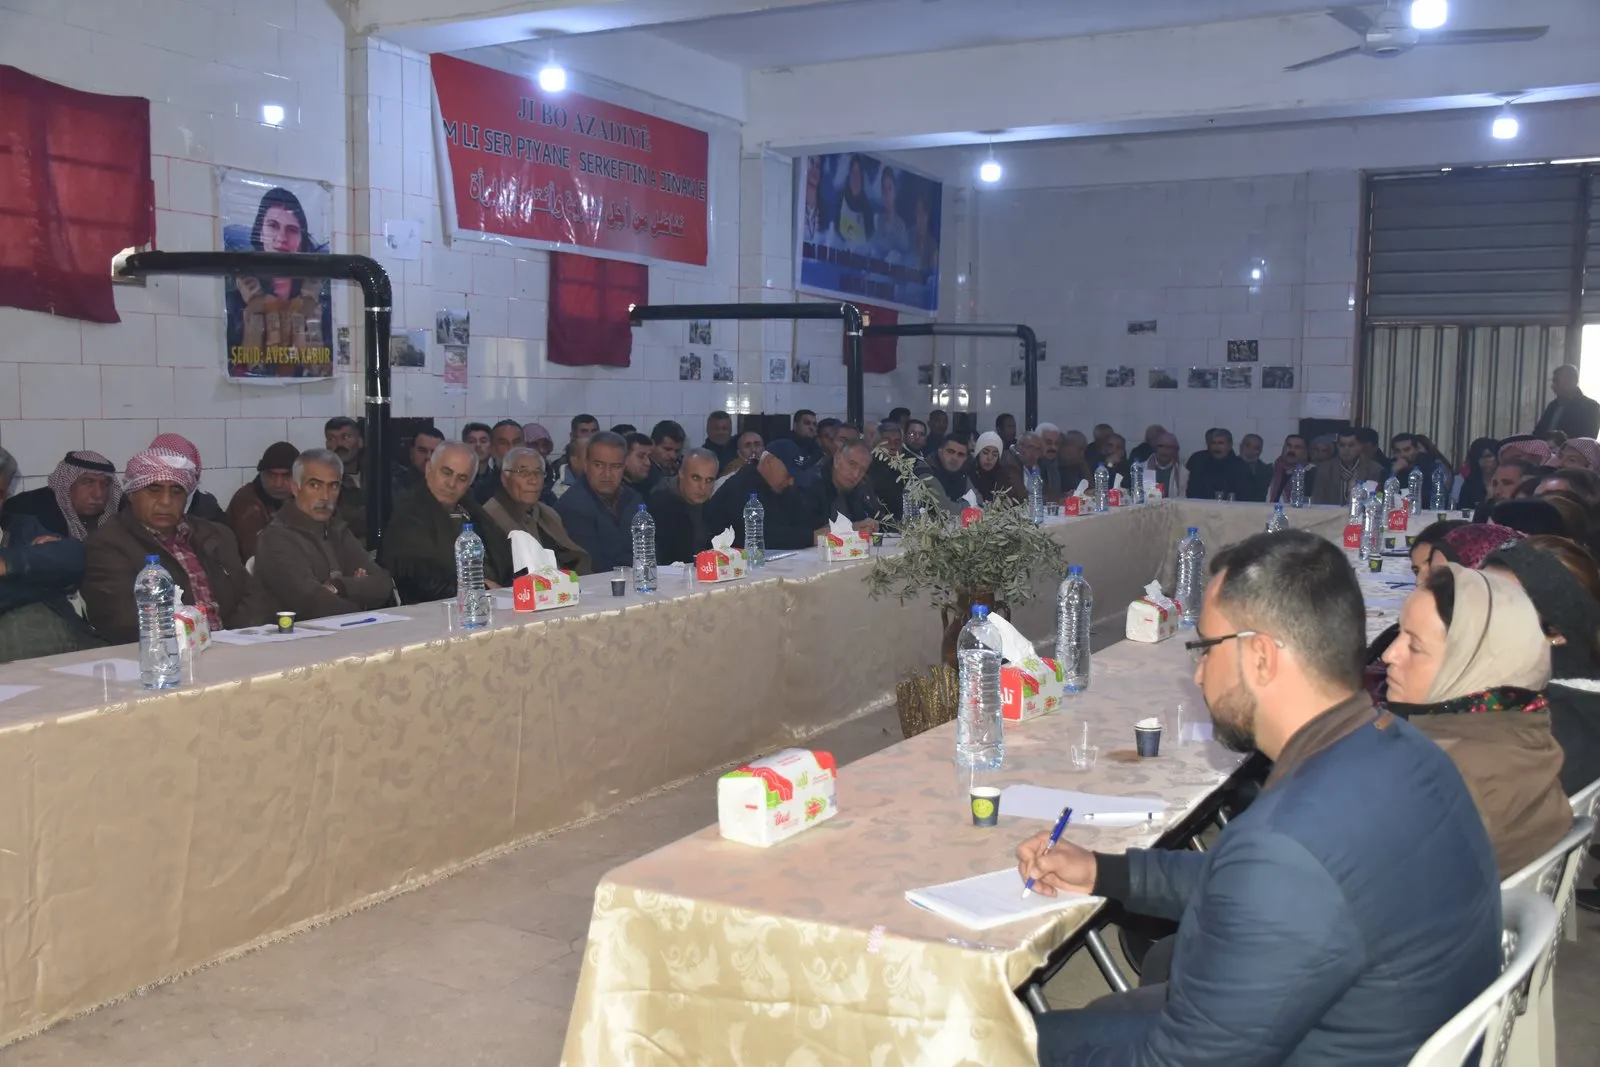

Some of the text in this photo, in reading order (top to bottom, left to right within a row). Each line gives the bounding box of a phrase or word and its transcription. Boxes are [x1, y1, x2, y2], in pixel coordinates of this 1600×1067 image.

[517, 97, 535, 121] JI
[541, 103, 568, 129] BO
[463, 122, 480, 150] LI
[484, 129, 513, 157] SER
